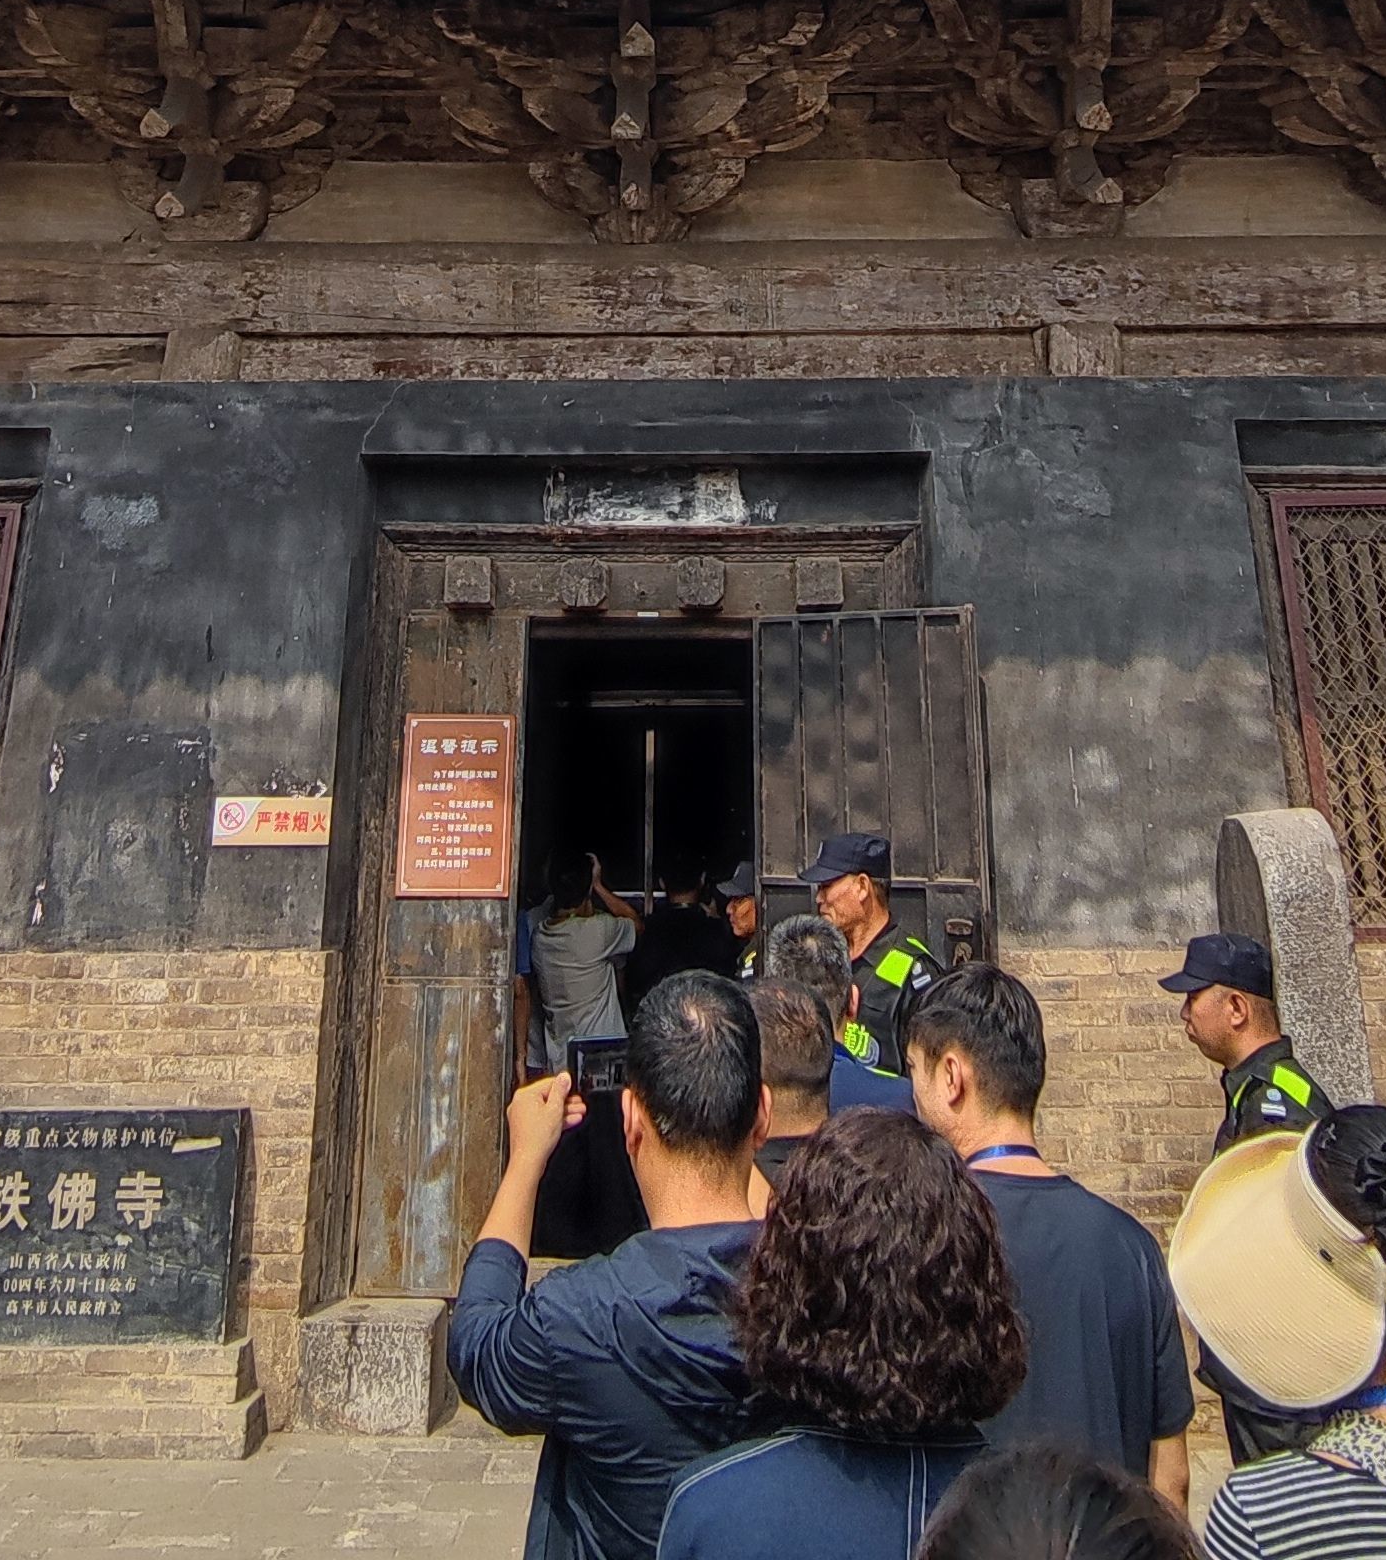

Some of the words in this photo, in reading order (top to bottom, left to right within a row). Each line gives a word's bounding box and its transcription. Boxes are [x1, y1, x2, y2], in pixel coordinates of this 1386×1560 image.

[420, 738, 499, 755] 温馨提示
[254, 810, 328, 833] 严禁烟火
[10, 1252, 128, 1271] 山西省人民政府
[6, 1298, 123, 1316] 高平市人民政府立
